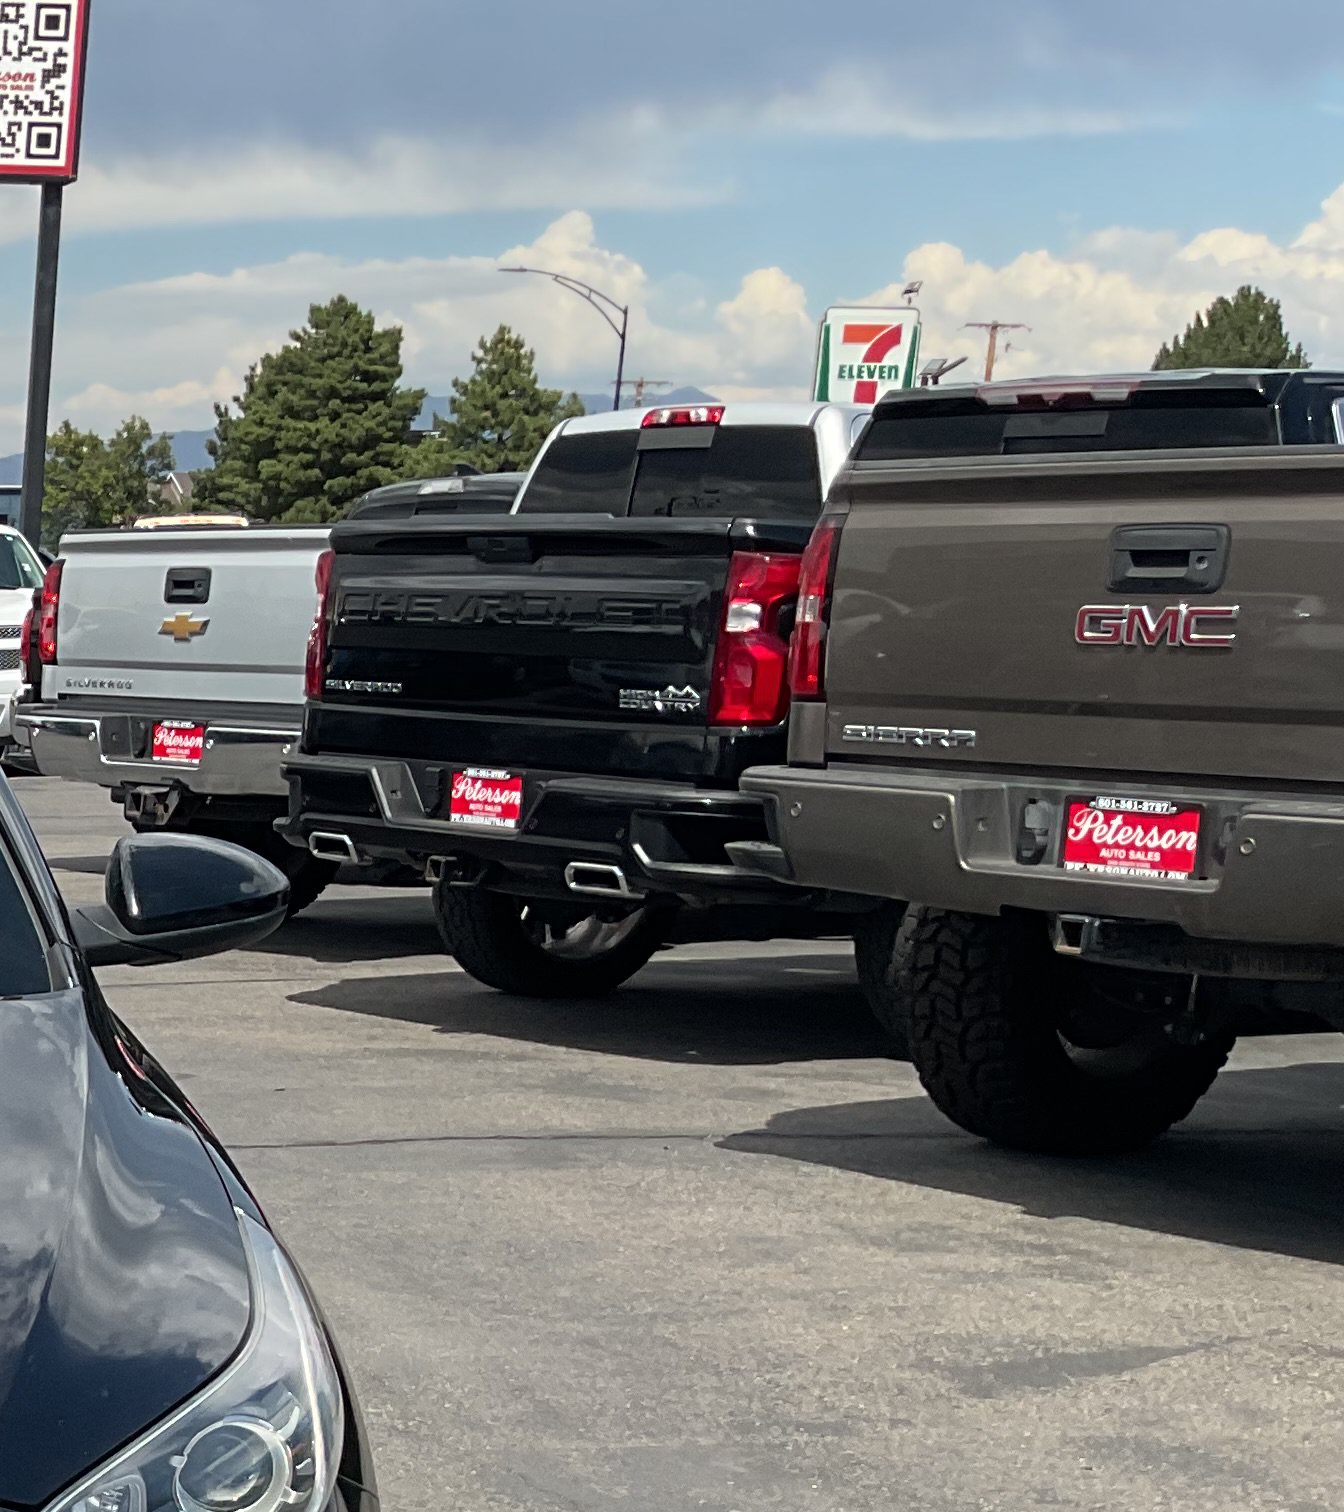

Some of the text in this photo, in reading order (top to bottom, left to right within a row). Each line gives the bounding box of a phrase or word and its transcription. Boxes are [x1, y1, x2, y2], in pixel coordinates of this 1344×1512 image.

[842, 323, 903, 404] 7
[1074, 603, 1240, 647] GMC
[66, 678, 133, 690] SILVERADO
[153, 726, 203, 748] Peterson
[842, 725, 976, 747] SIERRA
[451, 776, 521, 805] Peterson
[1067, 807, 1197, 851] Peterson
[1099, 848, 1161, 862] AUTO SALES
